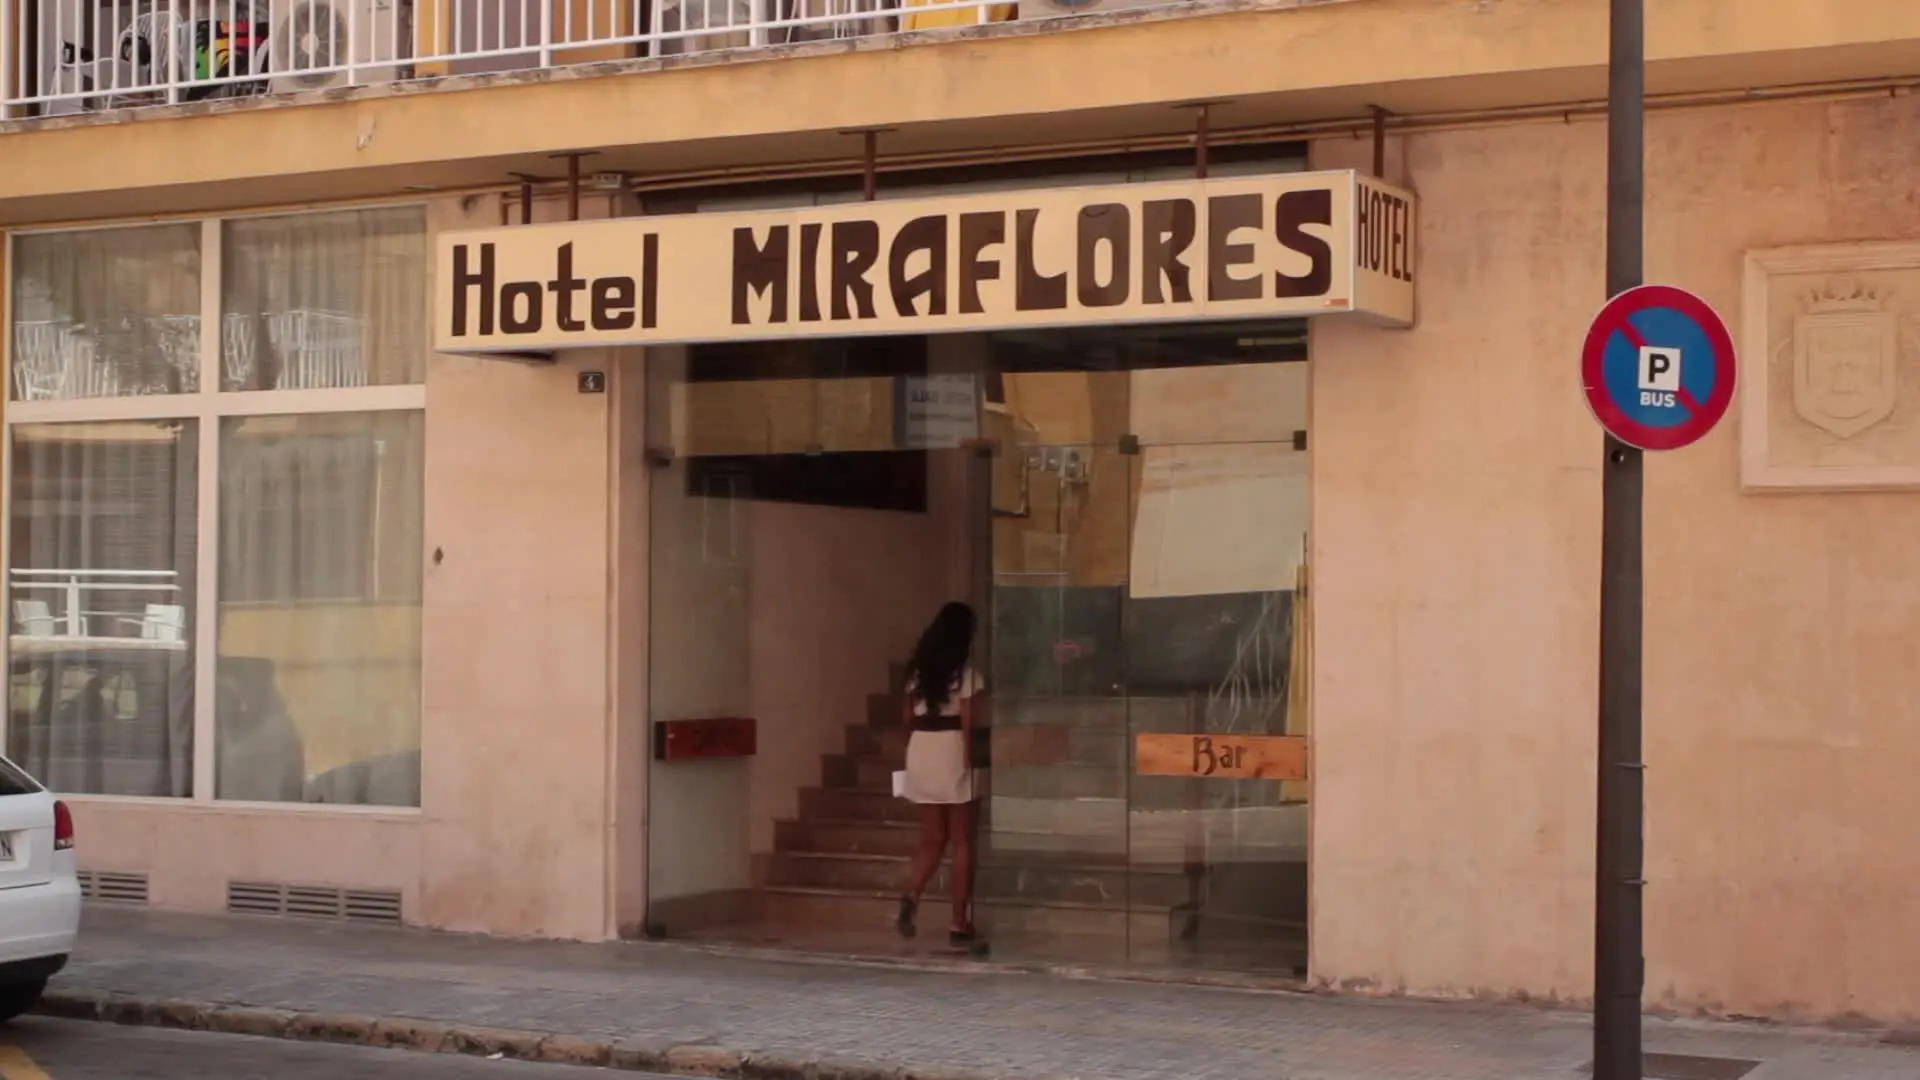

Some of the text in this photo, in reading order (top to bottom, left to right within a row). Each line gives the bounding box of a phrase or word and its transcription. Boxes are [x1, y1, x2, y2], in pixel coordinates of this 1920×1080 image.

[1358, 184, 1411, 282] HOTEL
[452, 189, 1332, 336] Hotel MIRAFLORES
[1648, 353, 1669, 383] P
[1640, 391, 1675, 408] BUS
[1192, 737, 1247, 775] Bar
